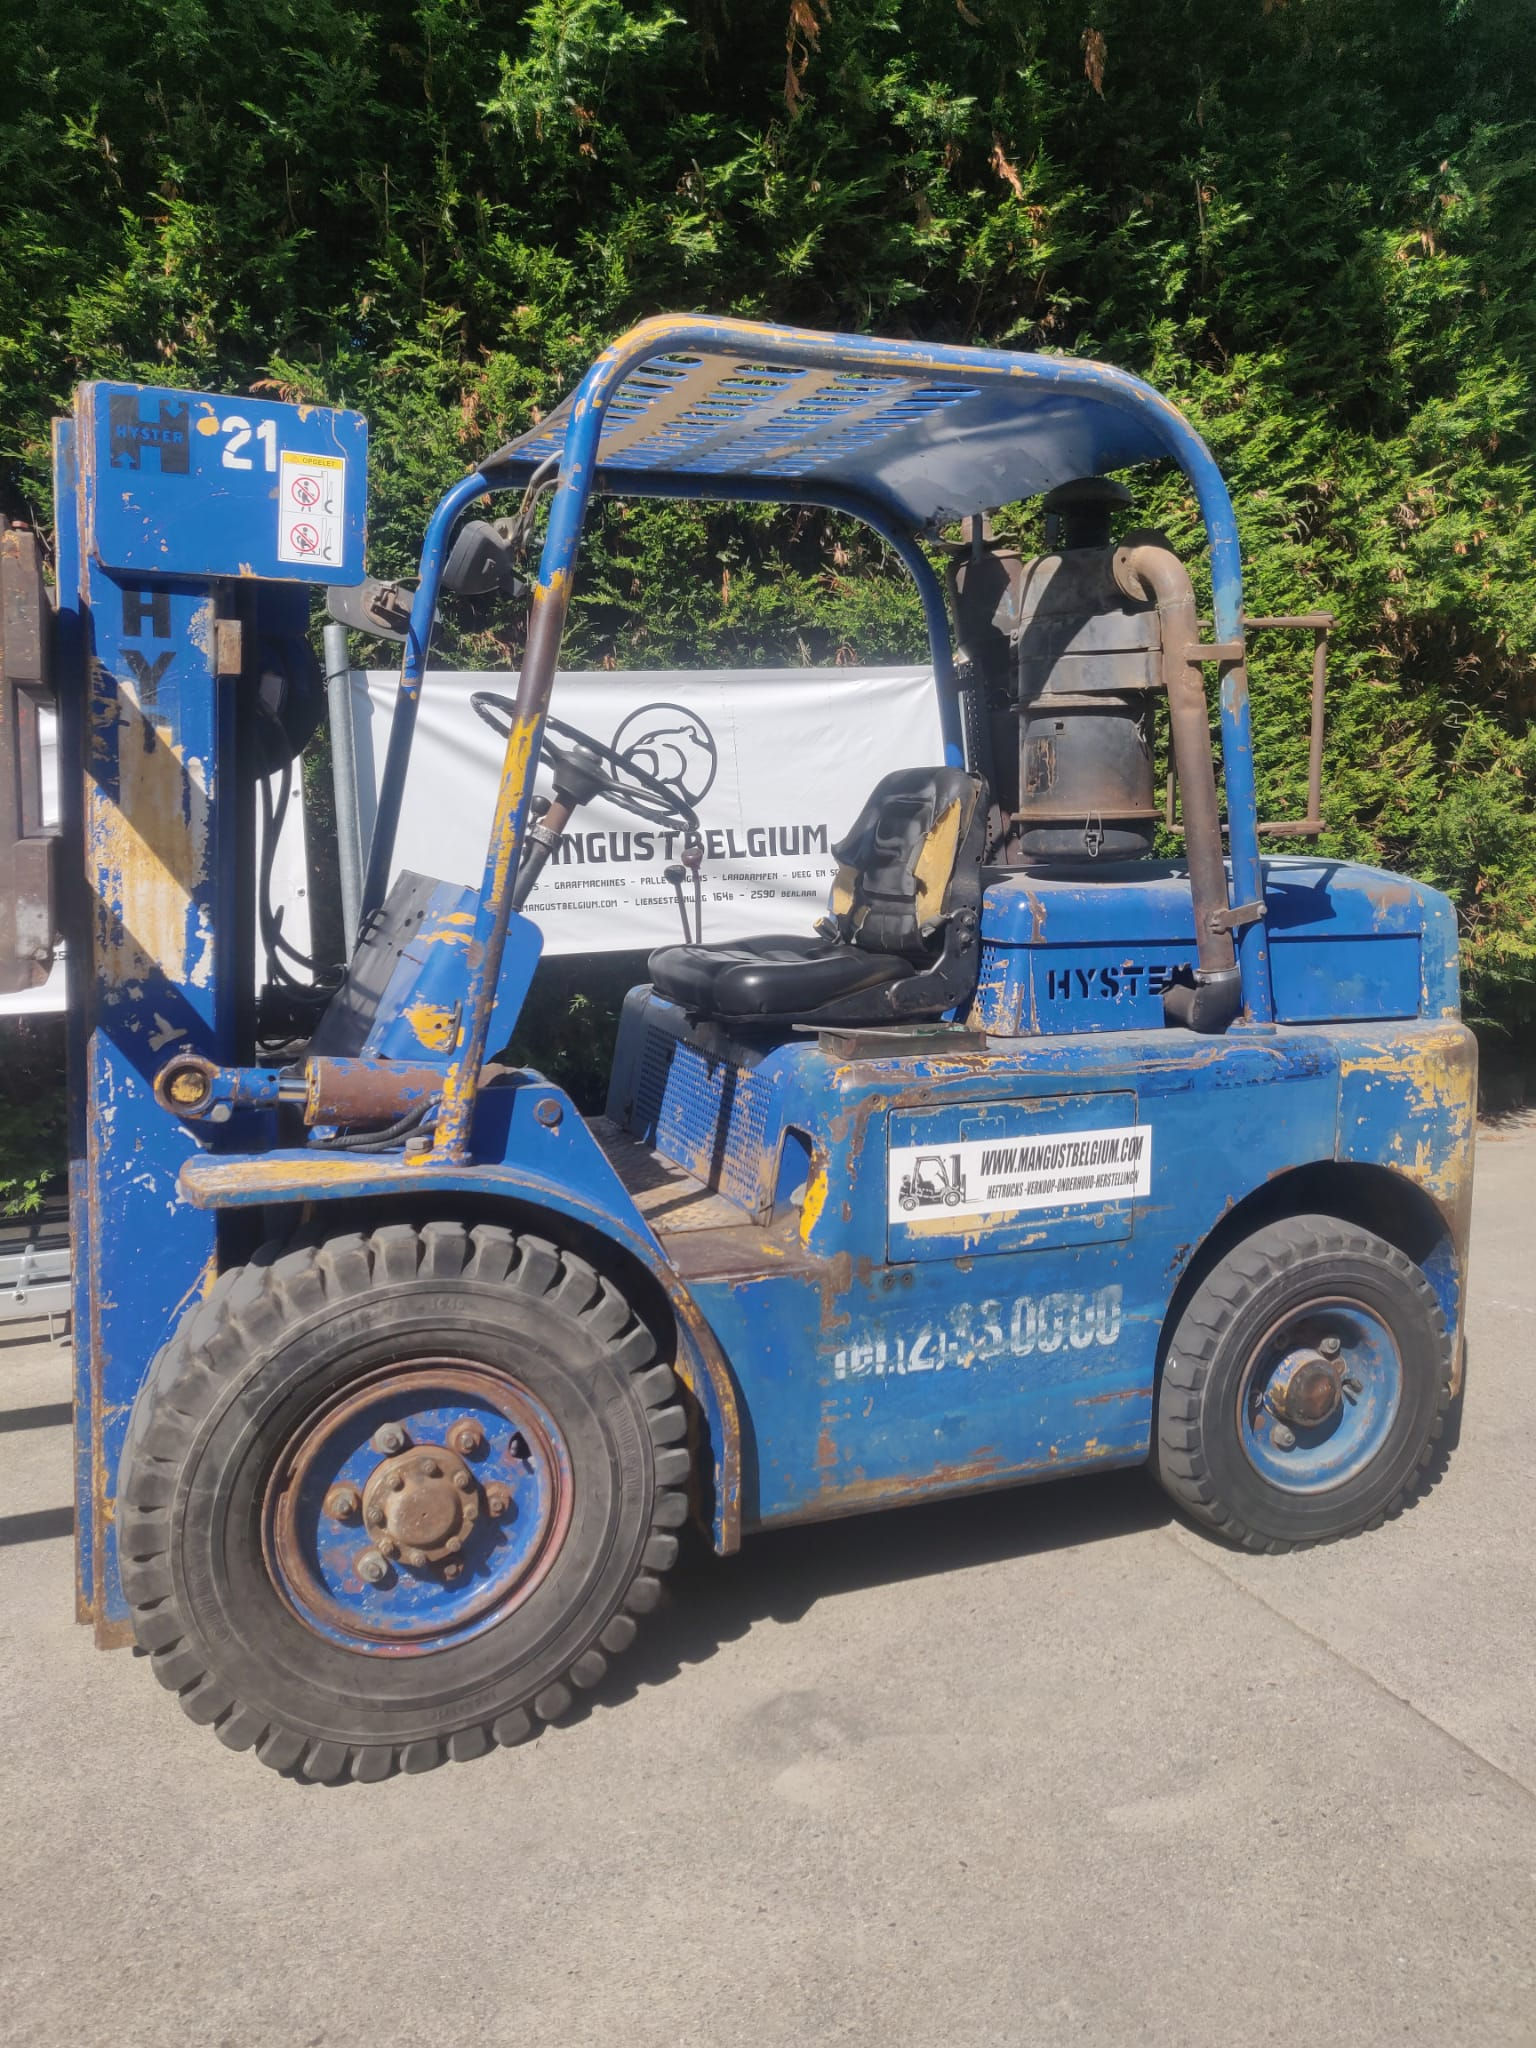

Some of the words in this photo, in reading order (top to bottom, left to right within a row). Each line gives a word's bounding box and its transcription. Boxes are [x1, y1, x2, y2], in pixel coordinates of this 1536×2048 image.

[116, 424, 184, 443] HYSTER
[221, 415, 277, 472] 21
[554, 878, 626, 890] GRAAFMACHINES
[722, 872, 778, 881] LAADRAMPEN
[791, 870, 812, 879] VEEG
[815, 869, 826, 877] EN
[750, 889, 776, 900] 2590
[780, 889, 817, 898] BERLAAR
[980, 1135, 1145, 1176] WWW.MANGUSTBELGIUM.COM
[986, 1182, 1024, 1200] HEFTRUCKS
